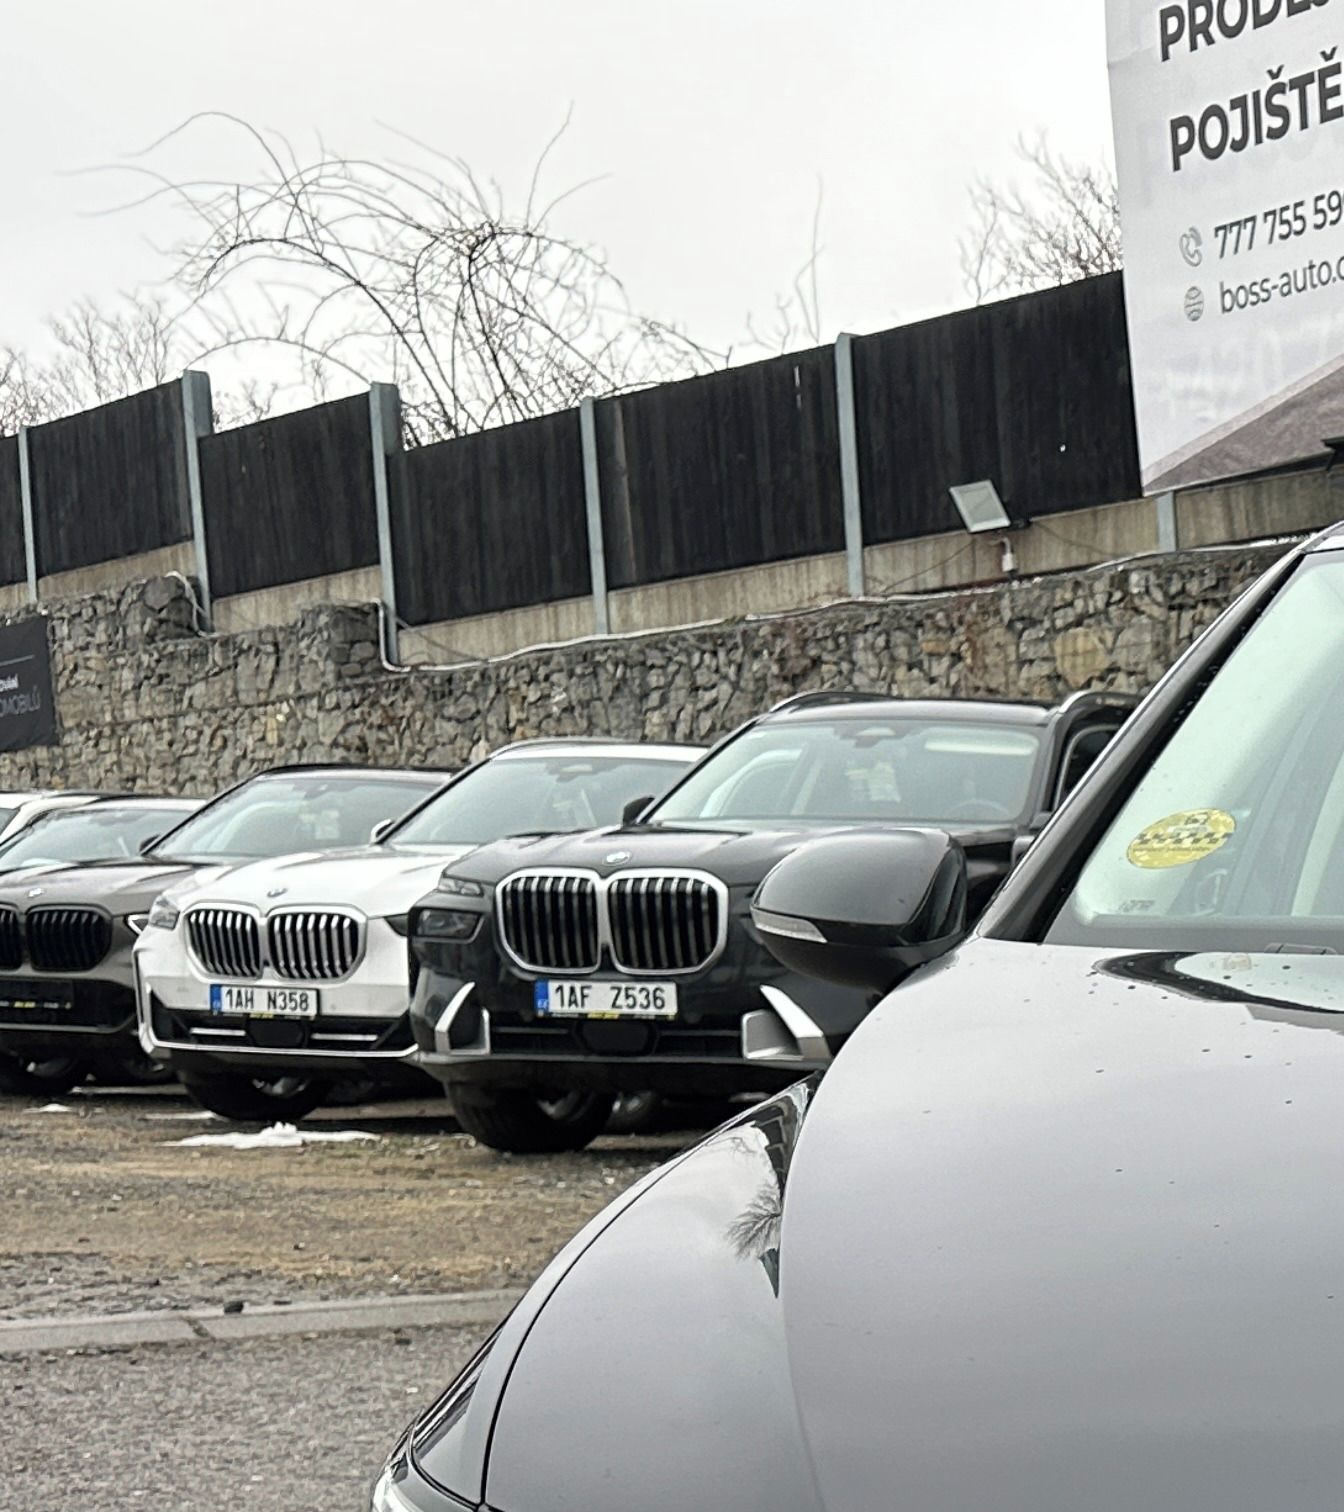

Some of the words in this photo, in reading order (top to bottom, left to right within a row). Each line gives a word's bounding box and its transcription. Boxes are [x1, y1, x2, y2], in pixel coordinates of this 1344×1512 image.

[1159, 0, 1331, 62] PROD
[1214, 215, 1257, 259] 777
[1263, 200, 1307, 245] 755
[225, 988, 254, 1009] 1AH
[267, 990, 309, 1012] N358
[555, 984, 592, 1008] 1AF
[609, 985, 666, 1010] Z536
